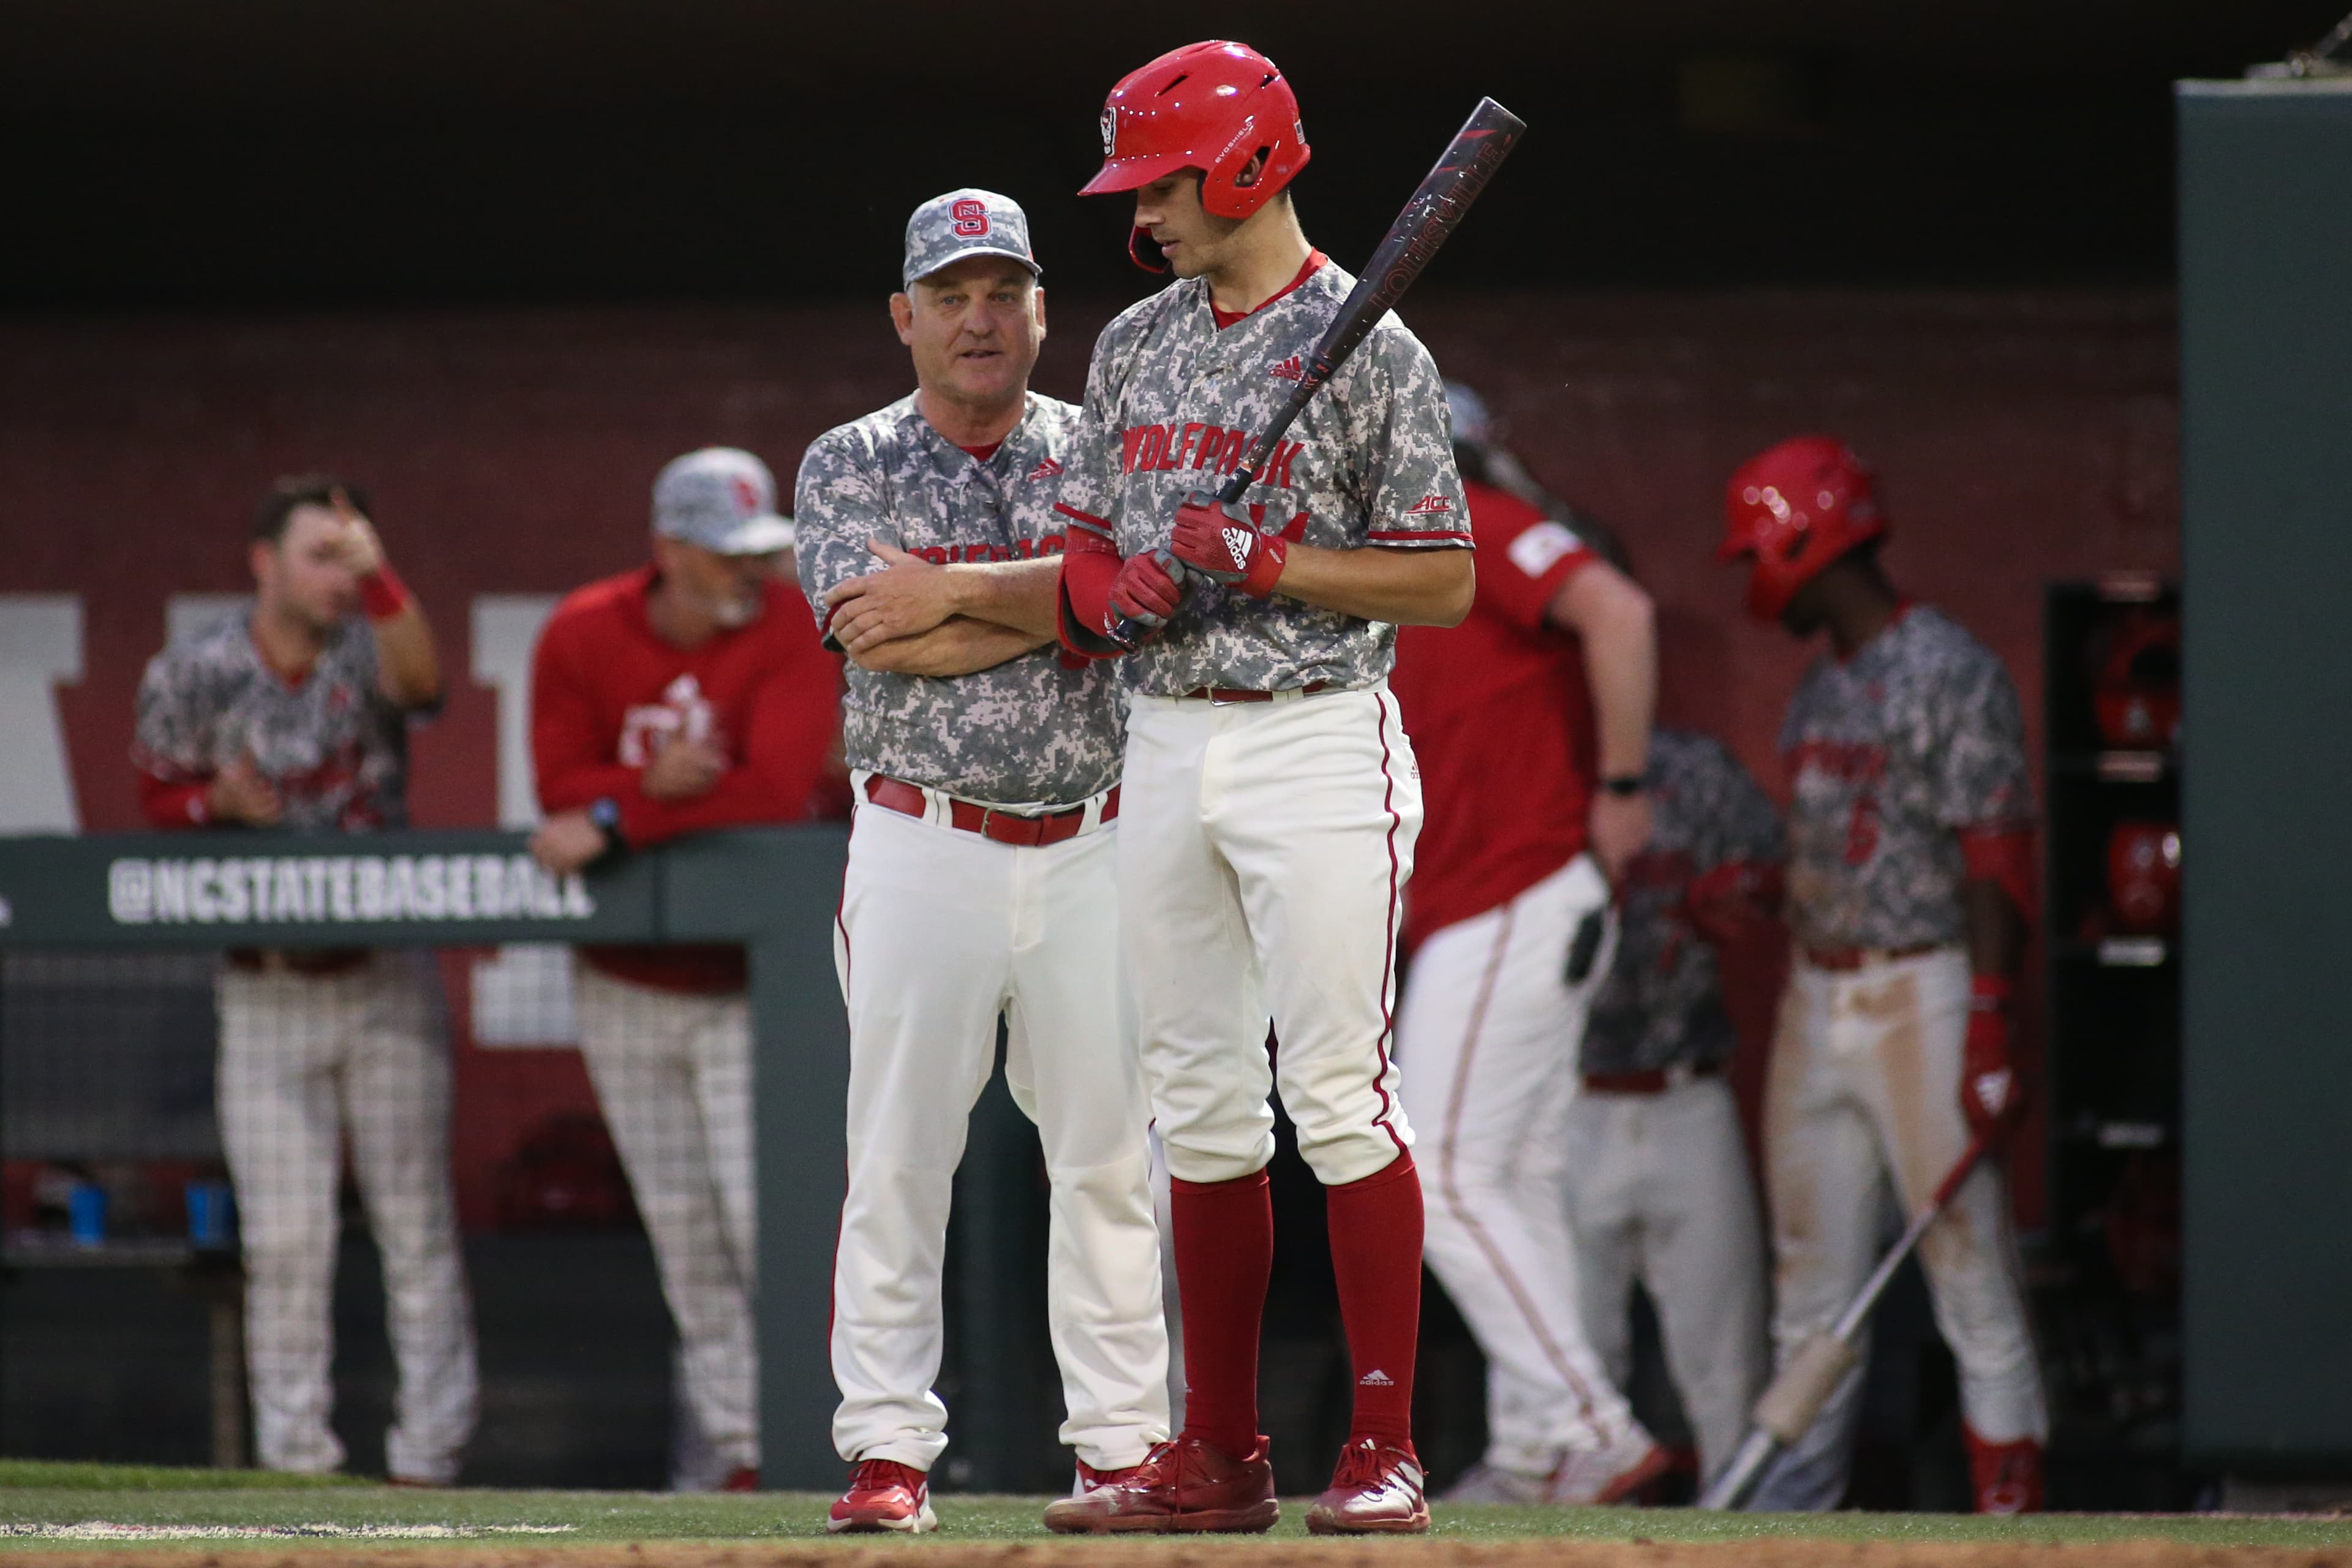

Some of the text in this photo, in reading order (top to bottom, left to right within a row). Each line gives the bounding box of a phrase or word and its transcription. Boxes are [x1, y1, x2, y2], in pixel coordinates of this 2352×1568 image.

[1215, 121, 1253, 164] EVOSHIELD
[1367, 140, 1507, 314] LOUISVILLE
[1411, 496, 1451, 510] ACC
[1222, 527, 1246, 570] adidas
[108, 855, 597, 923] @NCSTATEBASEBALL
